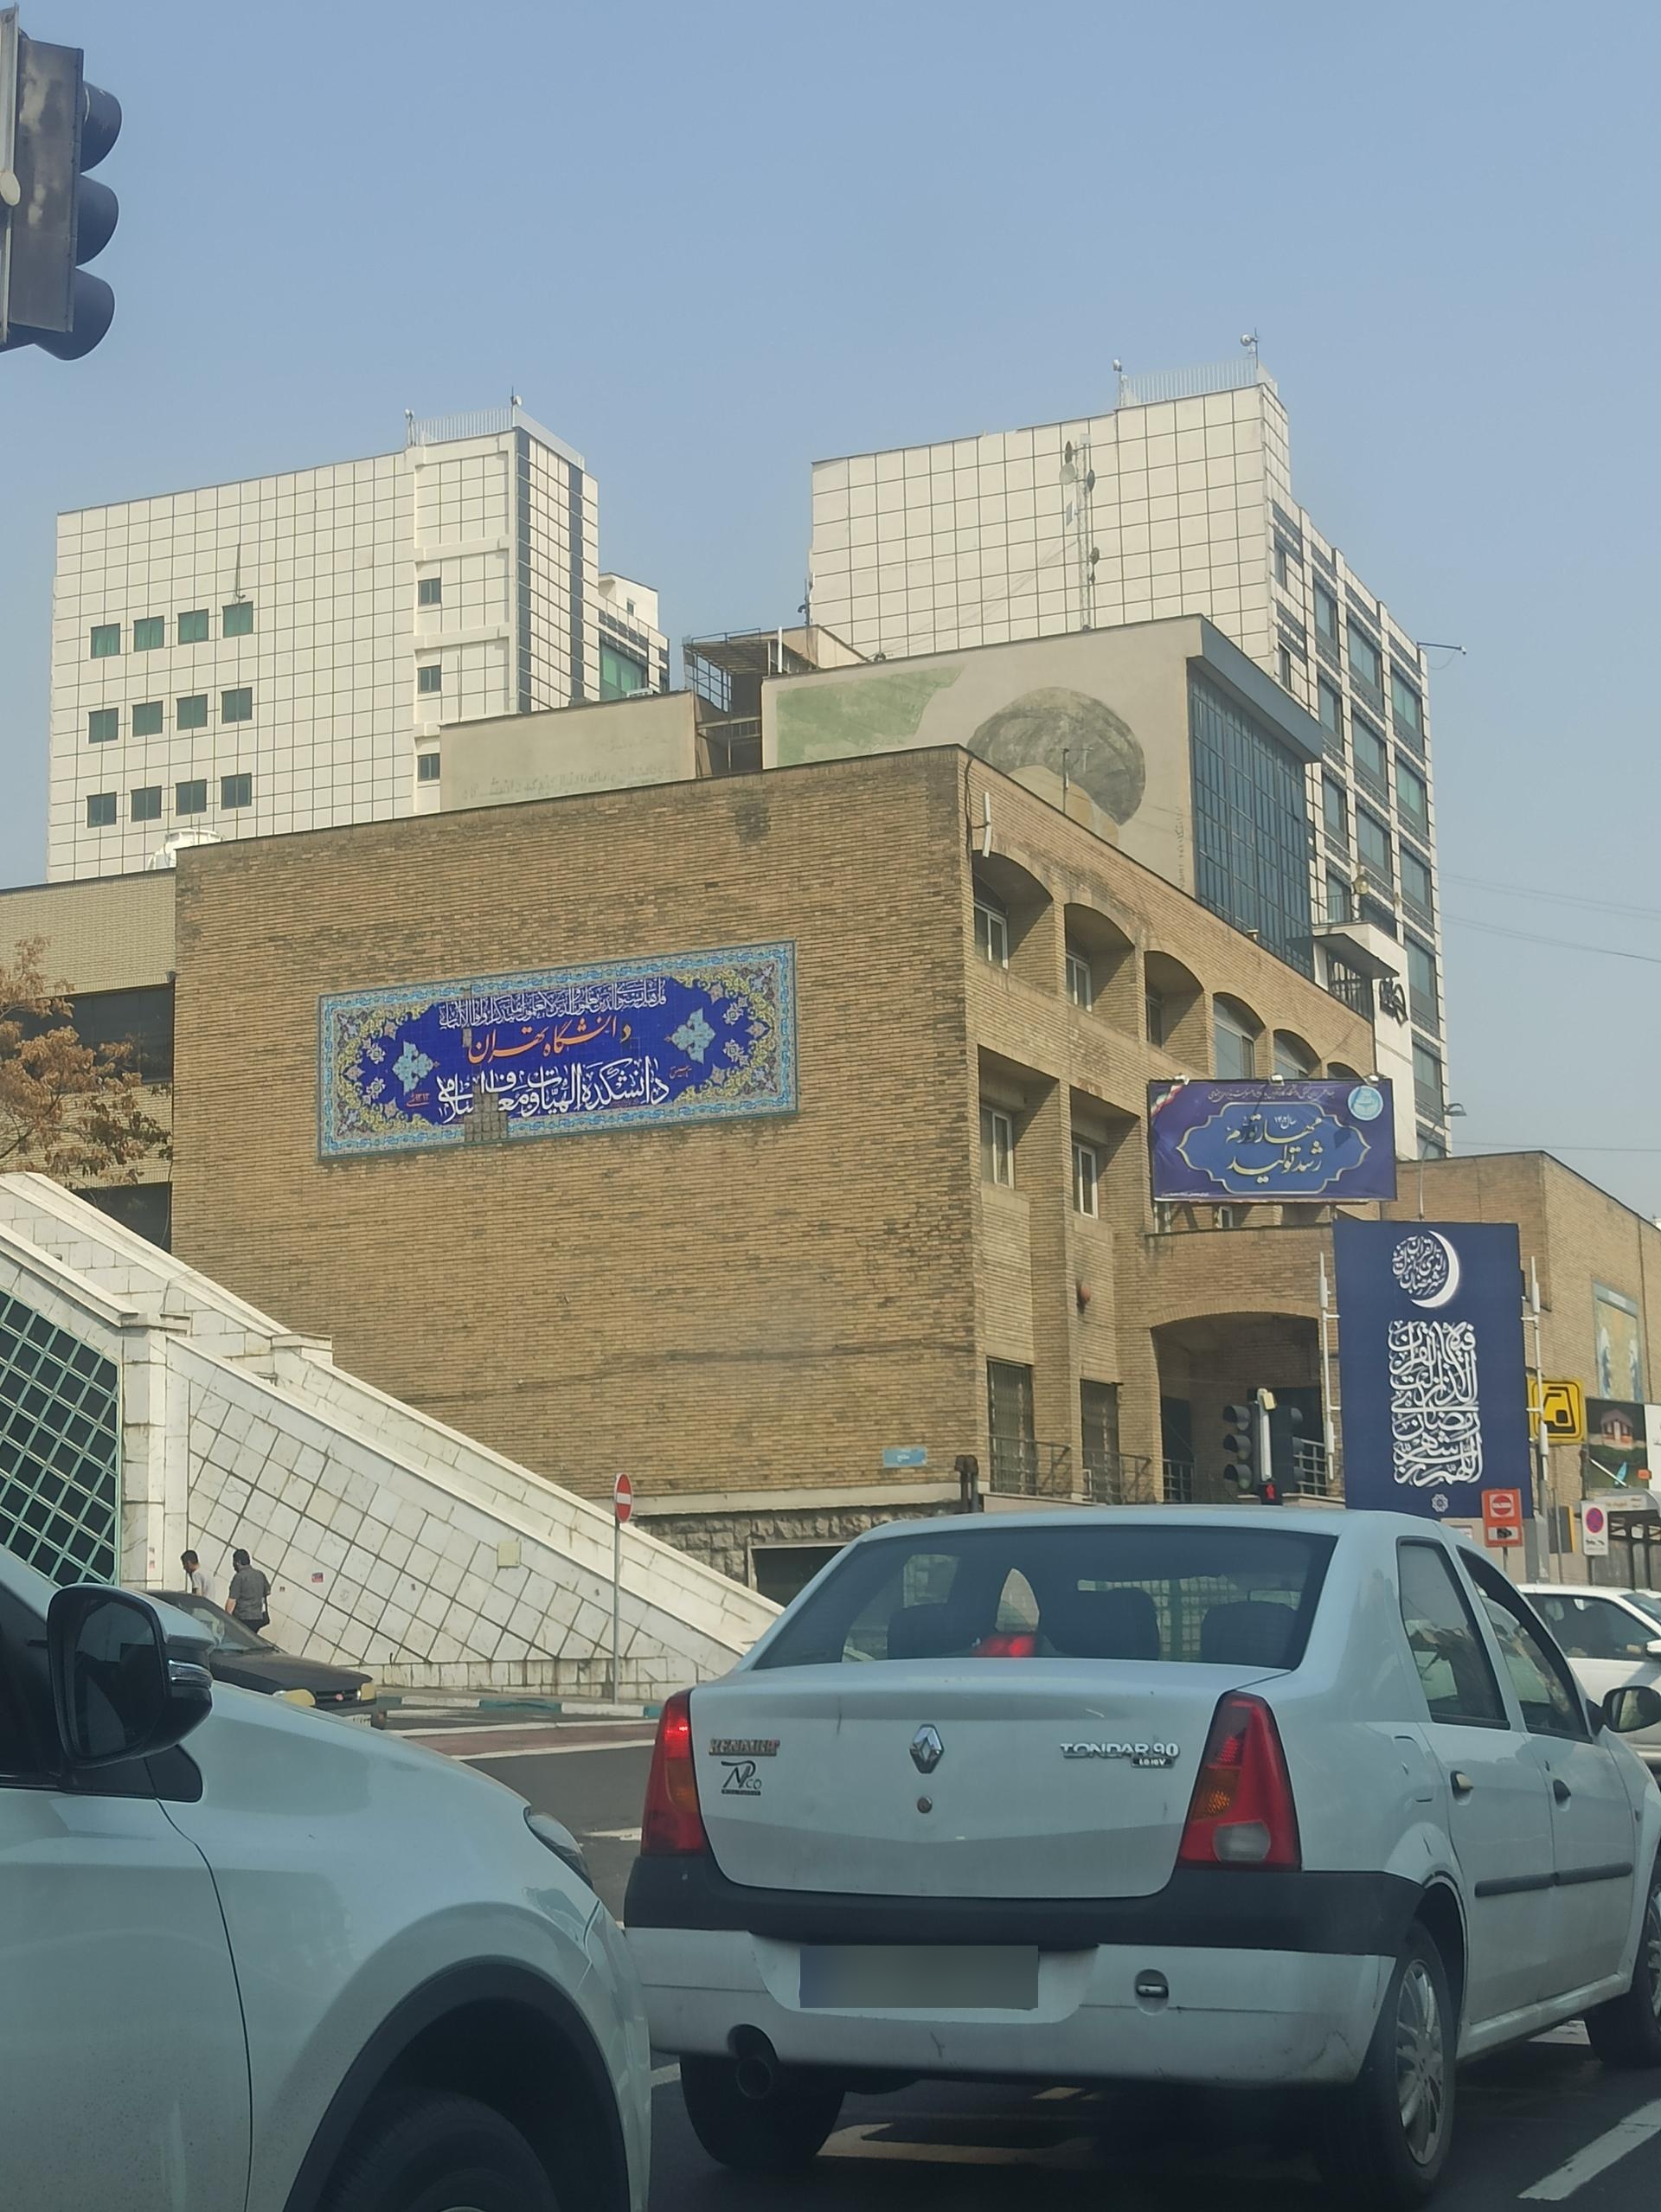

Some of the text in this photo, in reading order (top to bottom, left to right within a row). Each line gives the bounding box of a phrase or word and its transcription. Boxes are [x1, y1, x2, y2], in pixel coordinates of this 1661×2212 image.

[468, 1016, 632, 1063] دانشگاه تهران
[580, 1055, 670, 1111] دانشکده
[1254, 1116, 1323, 1144] مهار
[1226, 1140, 1324, 1183] رشد تولید
[1060, 1741, 1179, 1759] TONDAR 90
